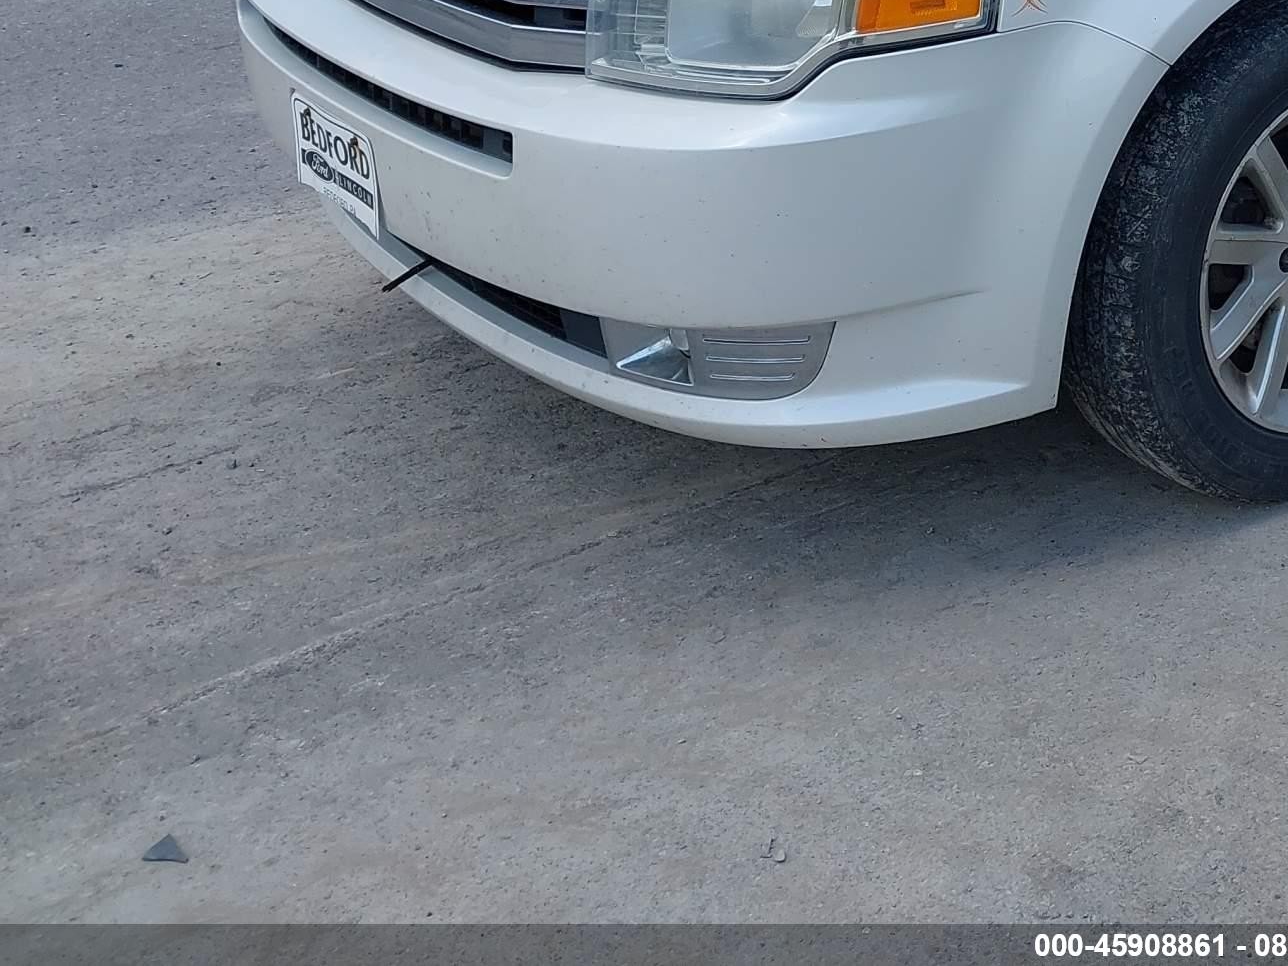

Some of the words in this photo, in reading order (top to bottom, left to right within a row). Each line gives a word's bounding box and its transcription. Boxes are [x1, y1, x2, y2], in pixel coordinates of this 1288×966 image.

[300, 111, 369, 181] BEDFORD
[312, 153, 329, 179] Ford
[339, 173, 373, 207] LINCOLN
